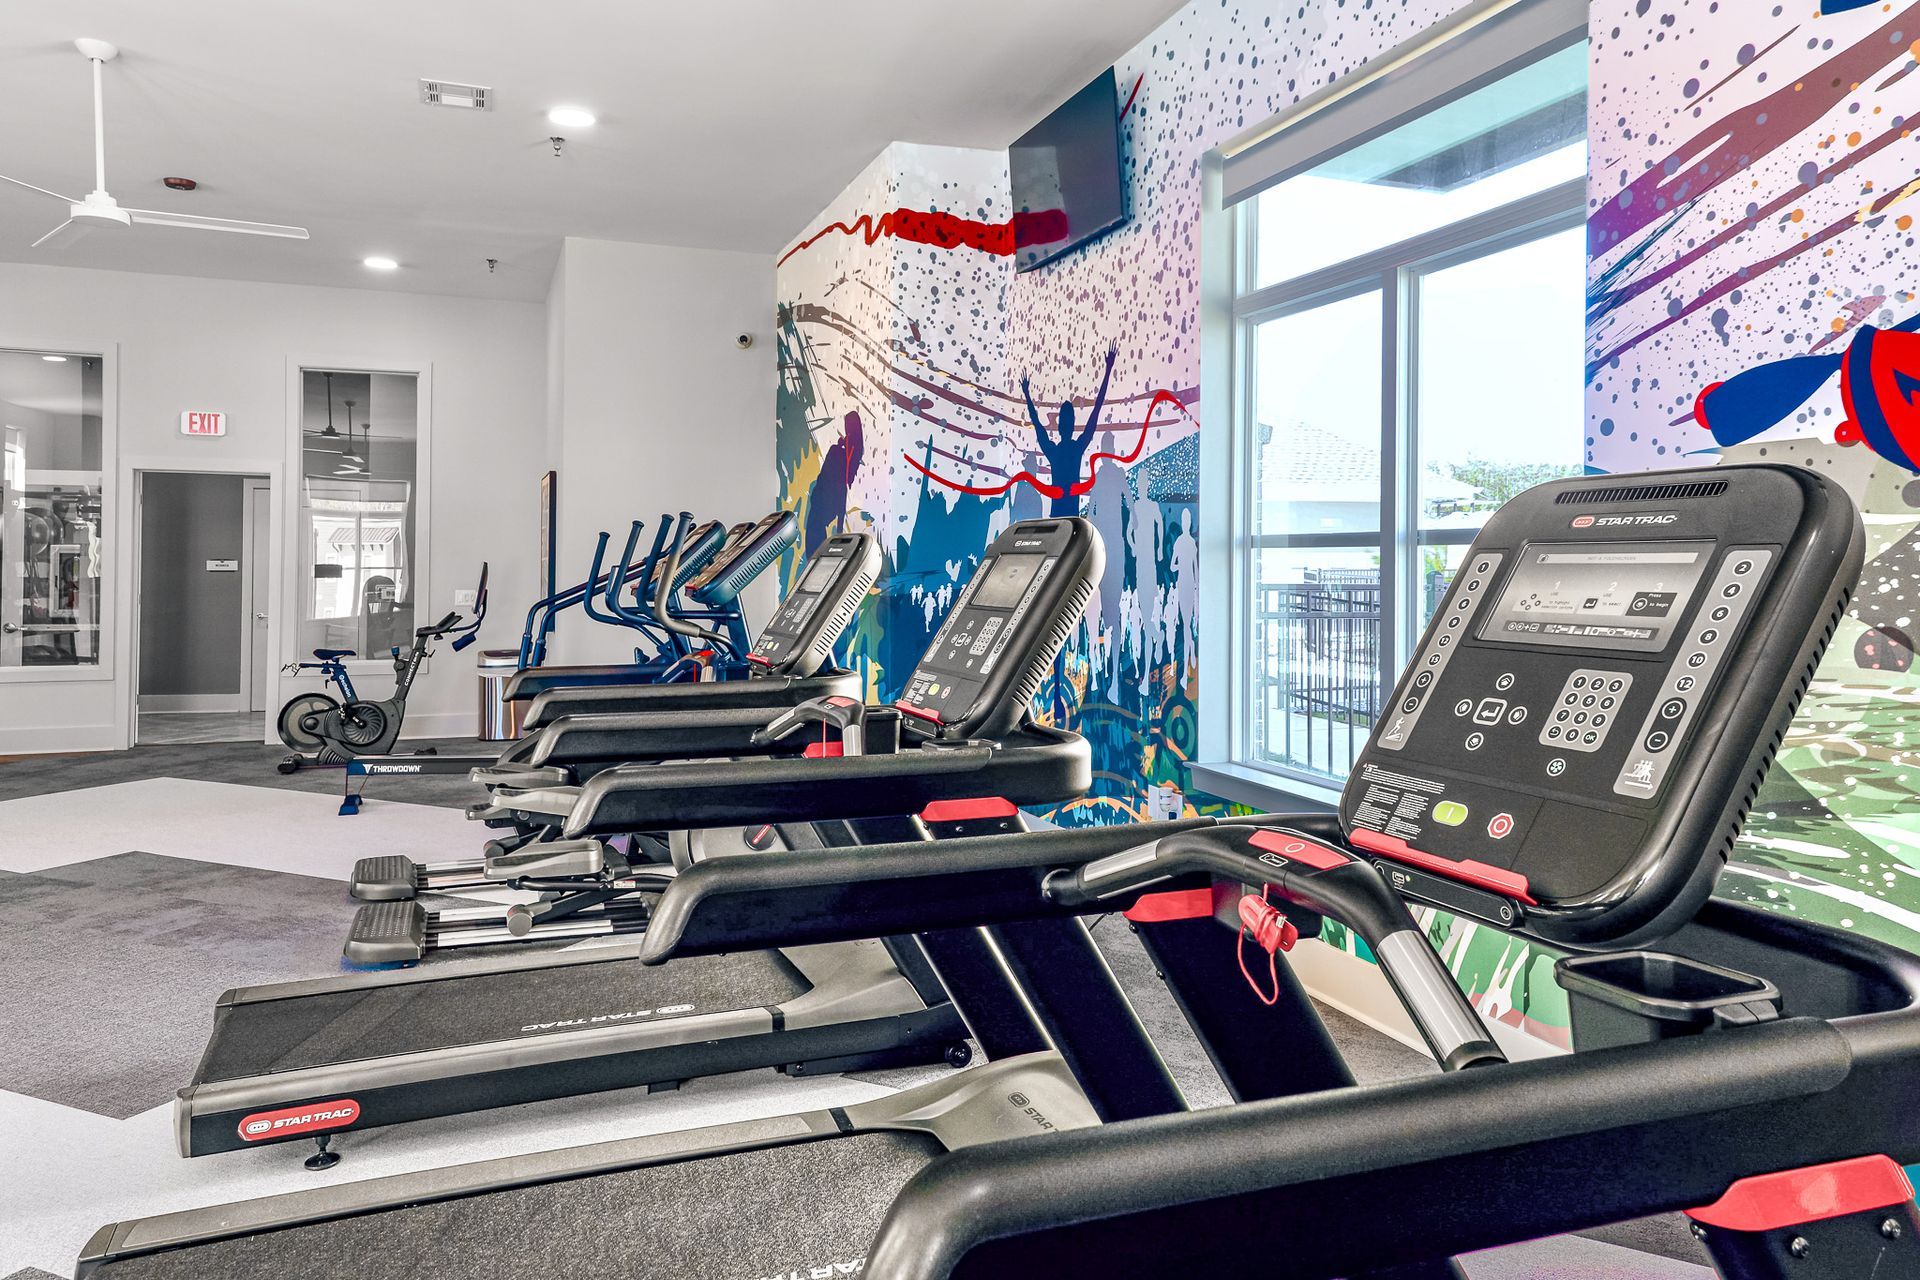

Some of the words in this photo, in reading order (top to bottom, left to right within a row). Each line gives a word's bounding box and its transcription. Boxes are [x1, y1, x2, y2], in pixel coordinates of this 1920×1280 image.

[188, 412, 220, 434] EXIT
[1595, 517, 1634, 526] STAR
[1634, 514, 1677, 525] TRAC
[1738, 564, 1747, 572] 2
[1727, 586, 1736, 595] 4
[1716, 610, 1724, 618] 6
[1704, 633, 1713, 641] 8
[1691, 655, 1704, 664] 10
[1593, 680, 1601, 688] 2
[1612, 682, 1620, 690] 3
[1679, 679, 1693, 689] 12
[1568, 695, 1575, 703] 4
[1585, 697, 1593, 705] 5
[1603, 699, 1611, 707] 6
[1560, 711, 1567, 719] 7
[1577, 714, 1585, 722] 8
[1595, 716, 1602, 724] 9
[1569, 731, 1576, 739] 0
[373, 765, 421, 773] THROWDOWN
[591, 1009, 652, 1022] STAR
[520, 1017, 588, 1032] TRAC
[273, 1115, 312, 1129] STAR
[313, 1107, 353, 1122] TRAC
[1024, 1107, 1054, 1130] STAR
